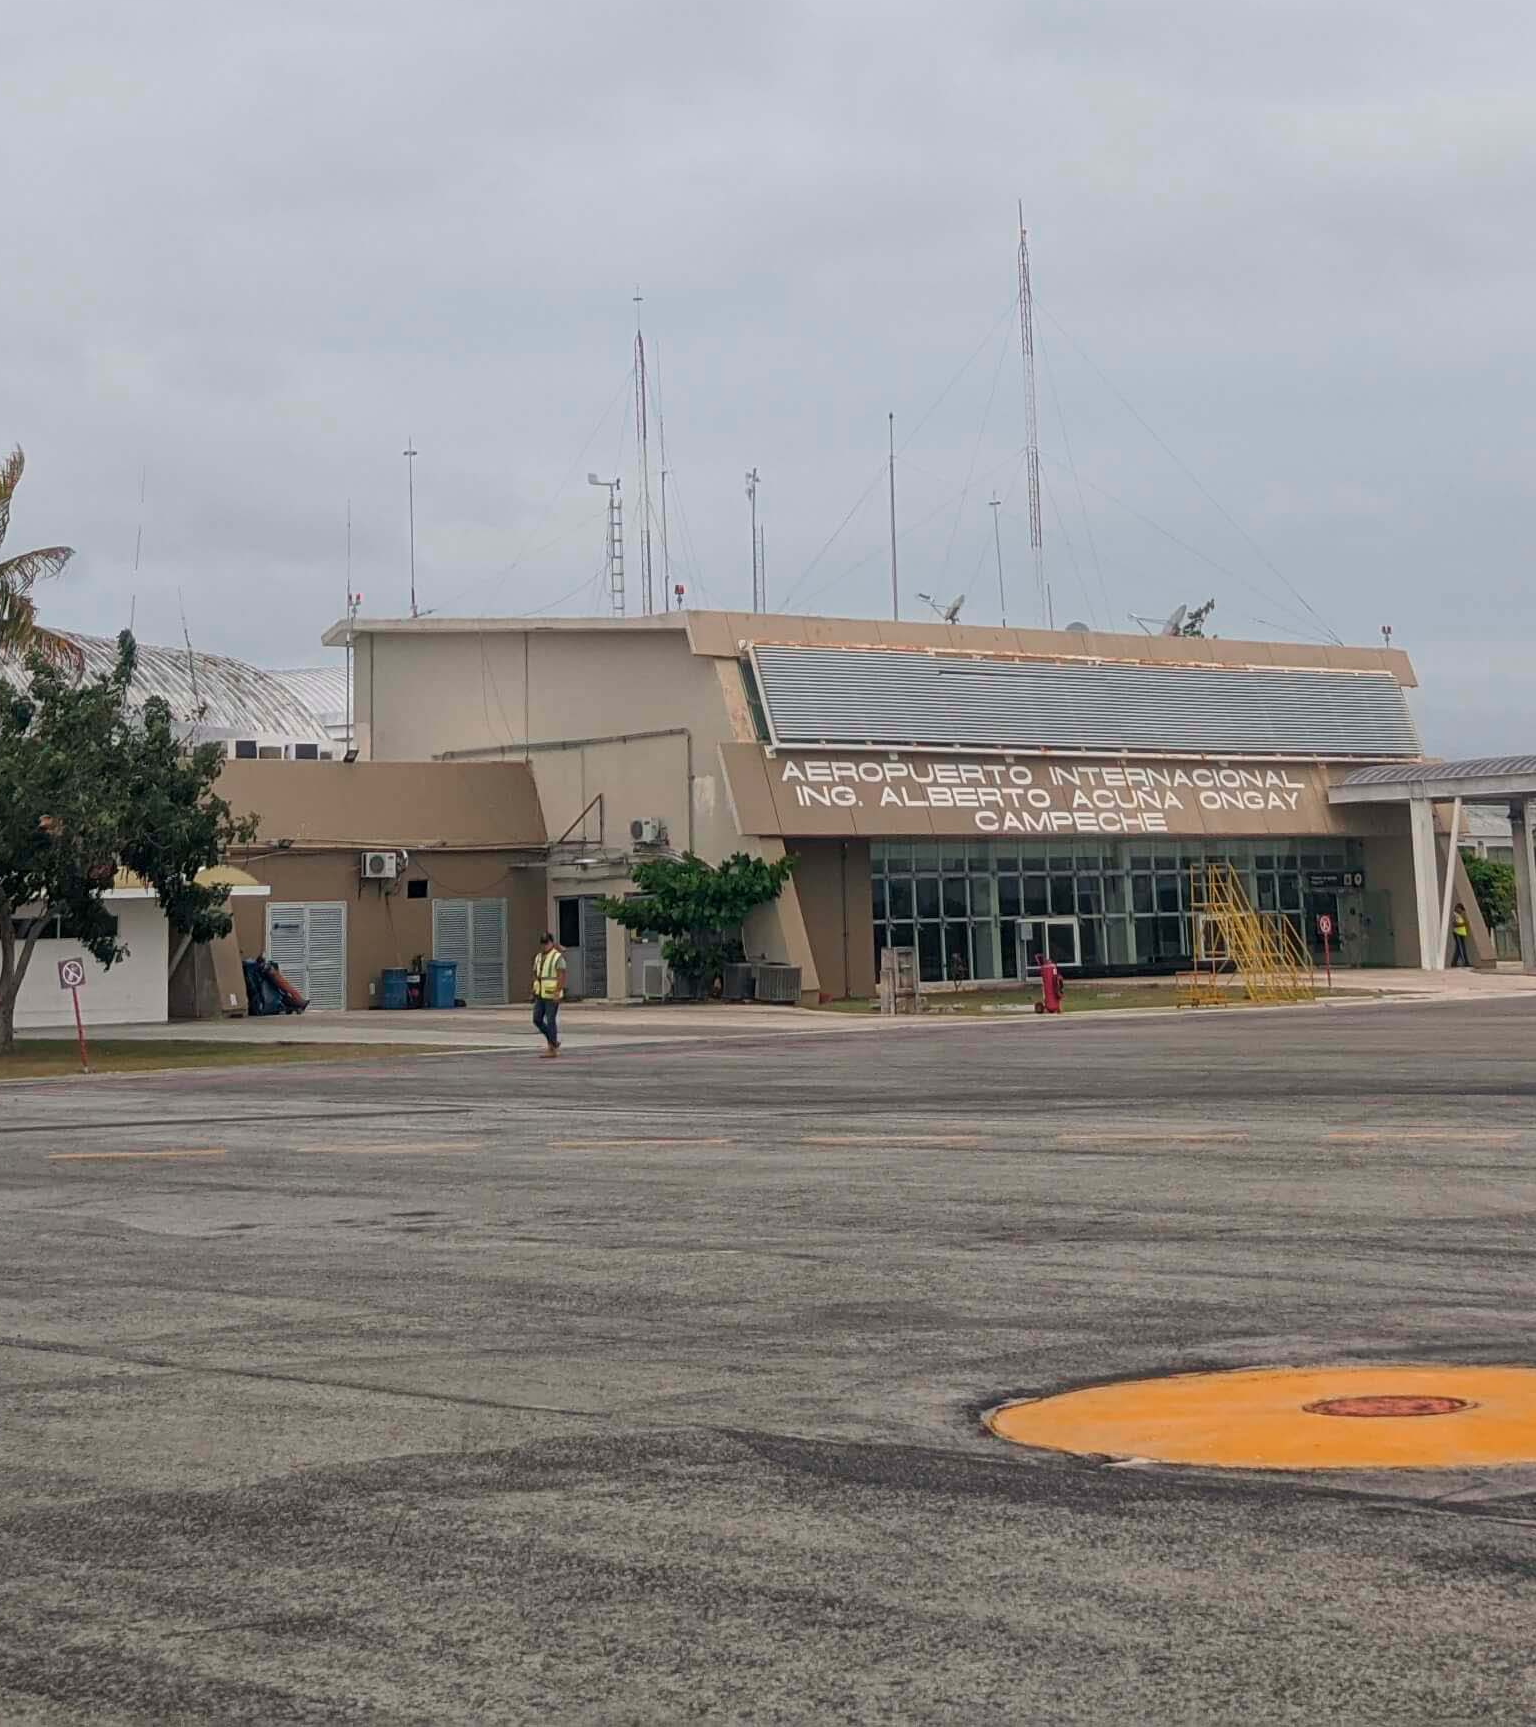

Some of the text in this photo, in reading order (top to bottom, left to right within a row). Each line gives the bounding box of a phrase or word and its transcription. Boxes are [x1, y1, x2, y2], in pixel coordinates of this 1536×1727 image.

[781, 761, 1305, 789] AEROPUERTO INTERNACIONAL
[796, 786, 1299, 810] ING. ALBERTO ACUÑA ONGAY
[974, 811, 1169, 833] CAMPECHE
